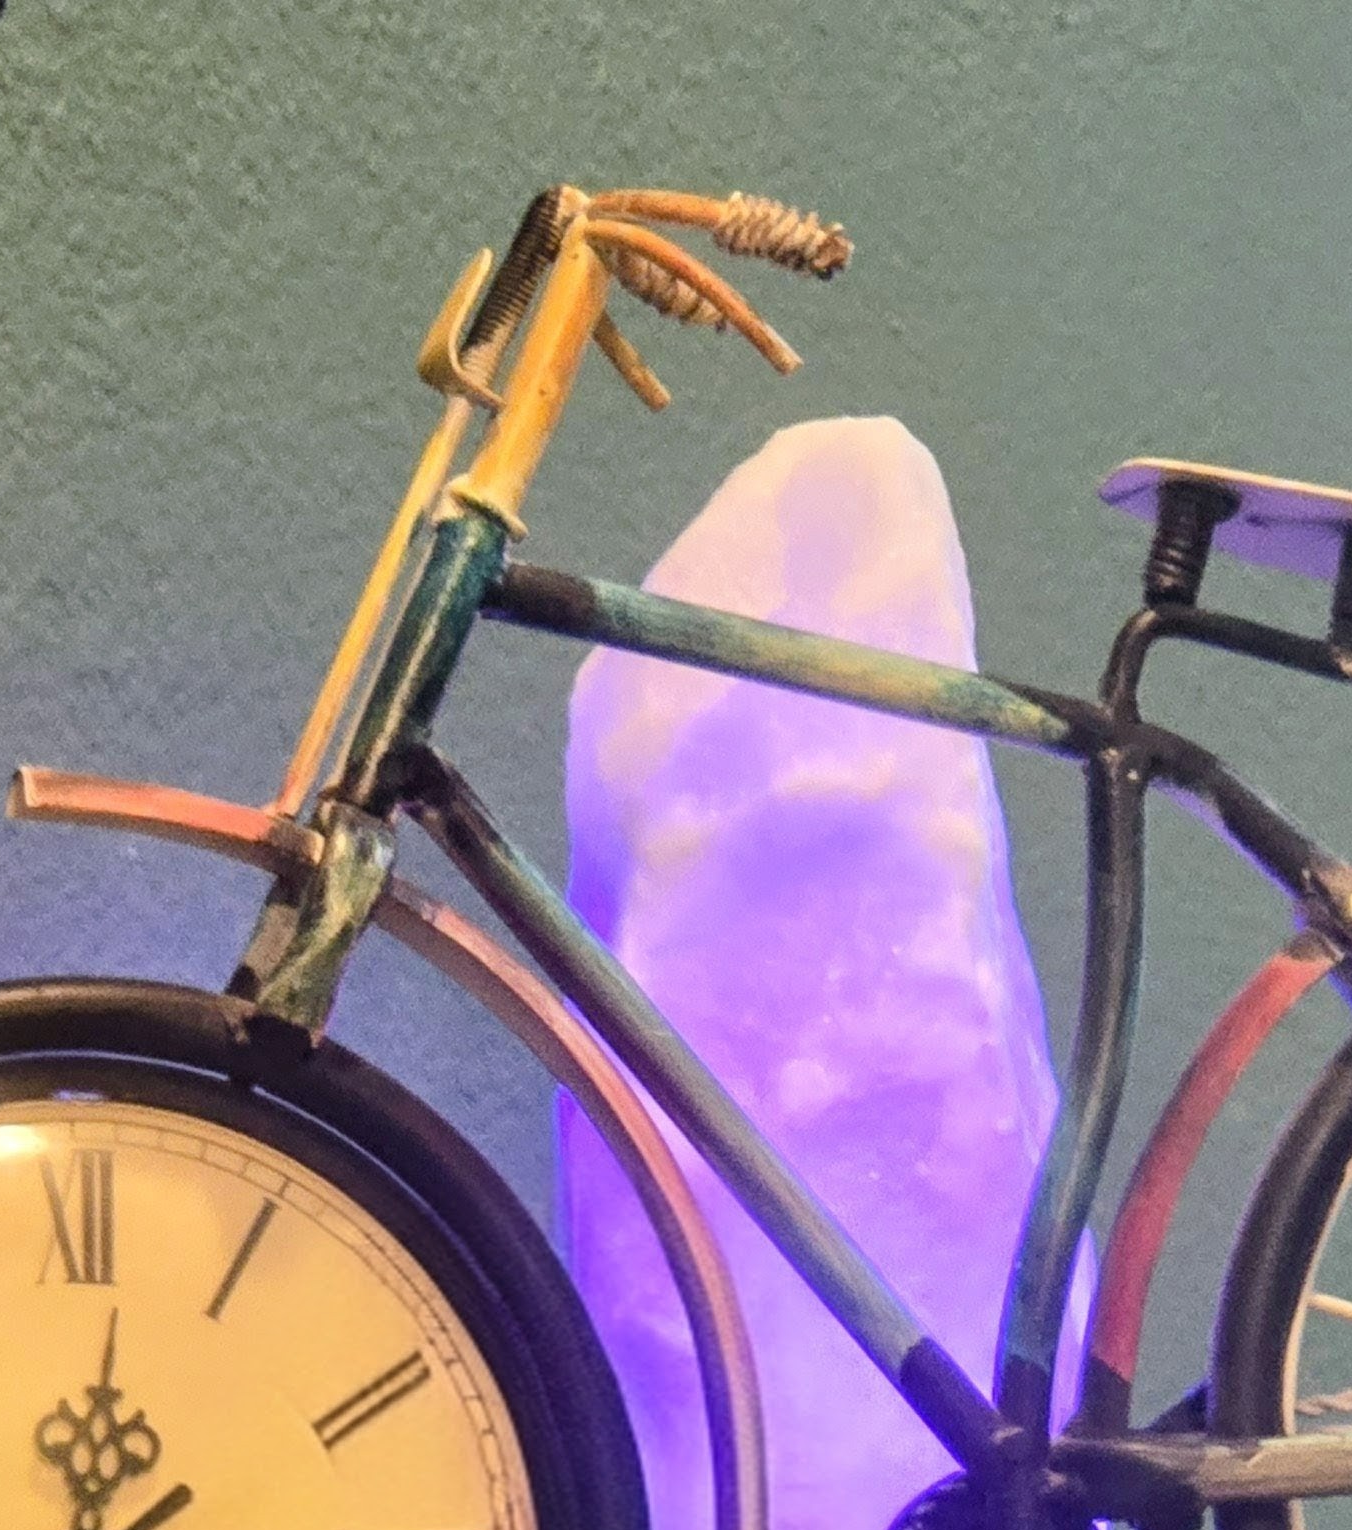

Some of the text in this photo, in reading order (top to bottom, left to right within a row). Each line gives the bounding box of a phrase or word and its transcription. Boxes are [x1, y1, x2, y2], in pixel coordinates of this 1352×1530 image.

[36, 1148, 116, 1286] XII
[201, 1197, 281, 1322] I
[310, 1350, 432, 1452] II
